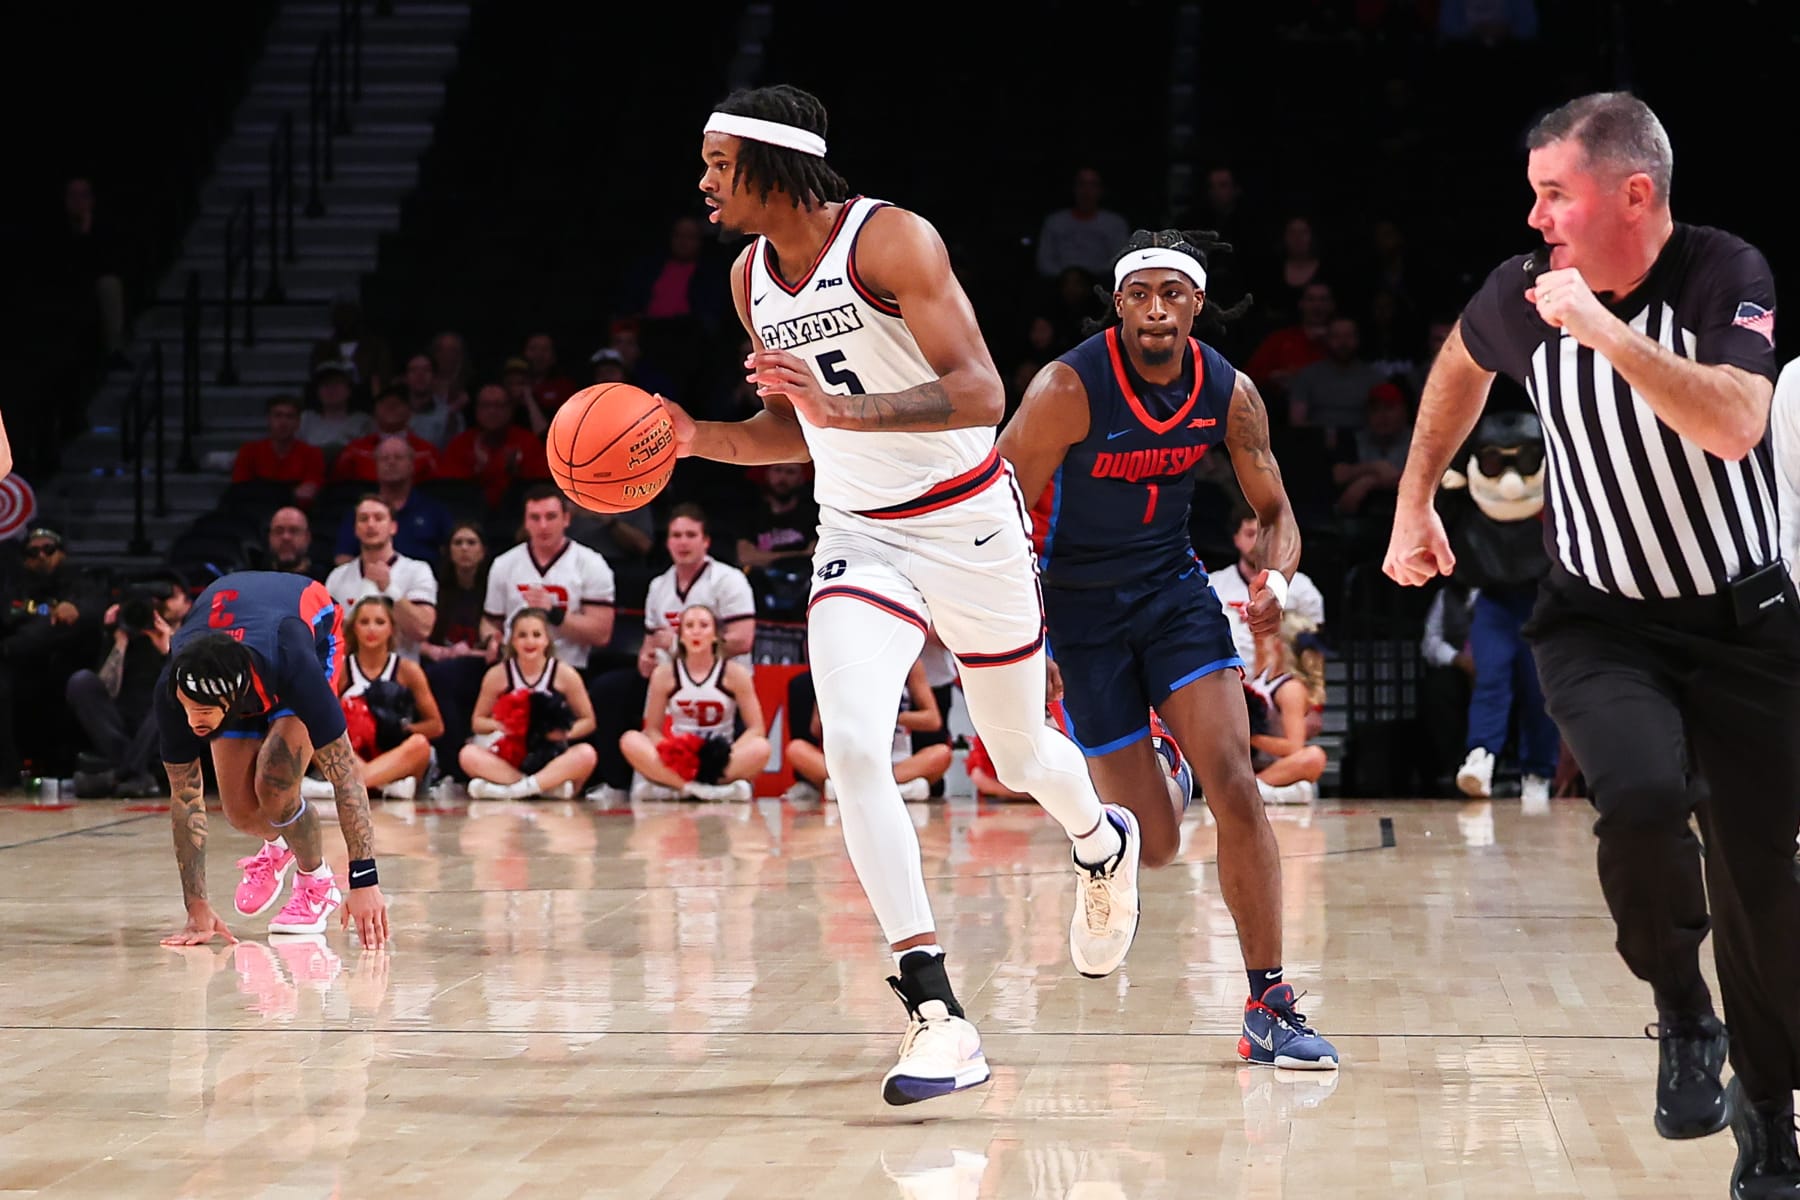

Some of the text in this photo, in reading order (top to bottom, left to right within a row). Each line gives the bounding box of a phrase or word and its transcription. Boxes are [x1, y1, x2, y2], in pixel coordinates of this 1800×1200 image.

[815, 277, 843, 292] A10
[762, 303, 864, 350] DAYTON
[815, 349, 866, 396] 5
[627, 429, 672, 470] EGACY
[1090, 444, 1209, 483] DUQUESN
[1143, 483, 1160, 525] 1
